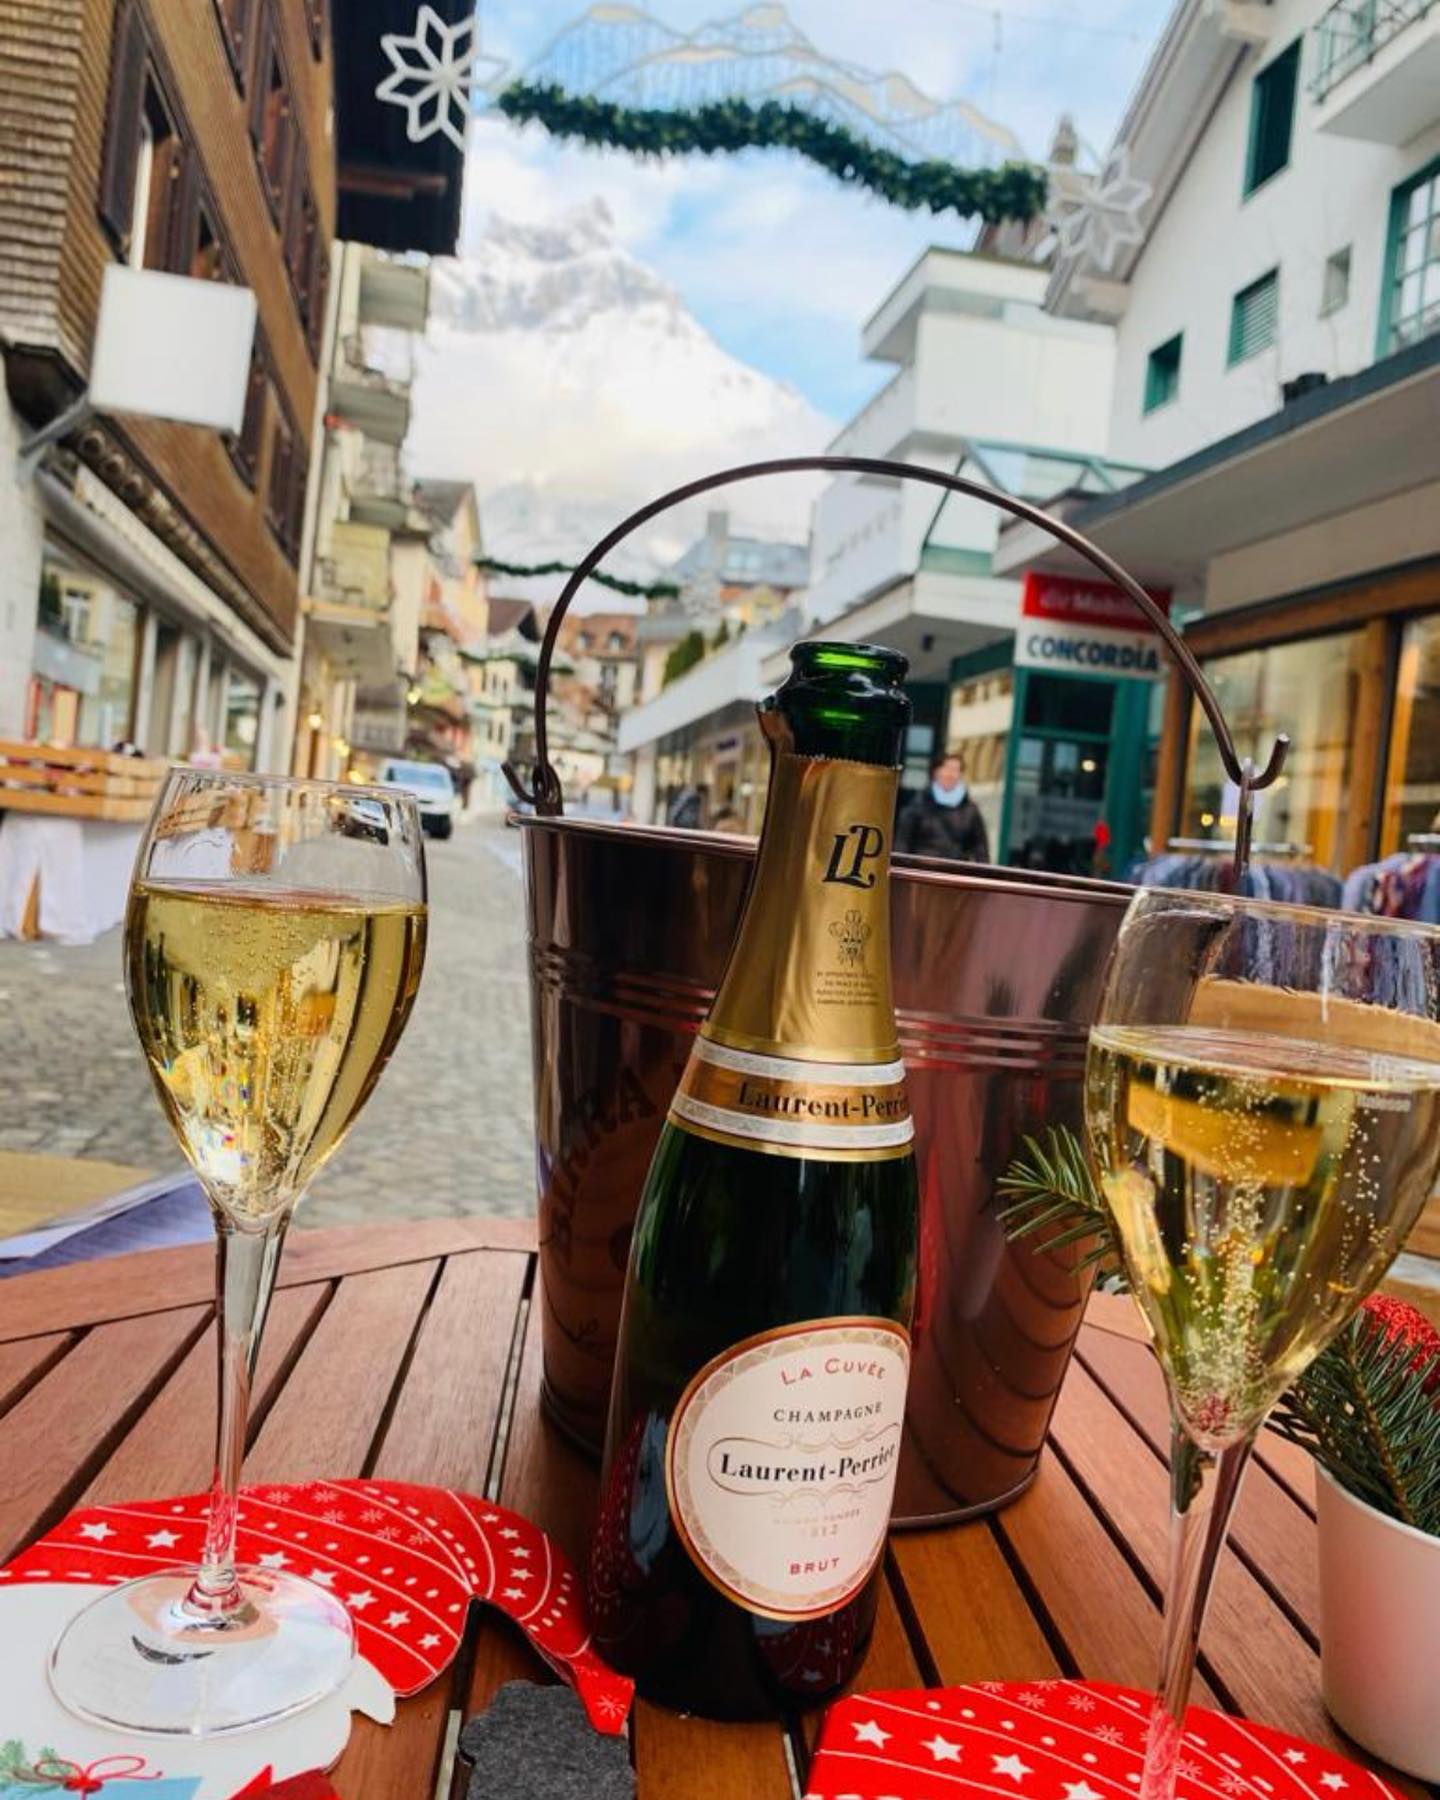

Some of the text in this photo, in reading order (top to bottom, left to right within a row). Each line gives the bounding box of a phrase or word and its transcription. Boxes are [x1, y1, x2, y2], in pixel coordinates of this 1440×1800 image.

[821, 825, 884, 889] LP
[781, 1368, 813, 1386] LA
[773, 1401, 882, 1423] CHAMPAGNE
[720, 1443, 896, 1482] Laurent-Perrier
[789, 1557, 840, 1576] BRUT
